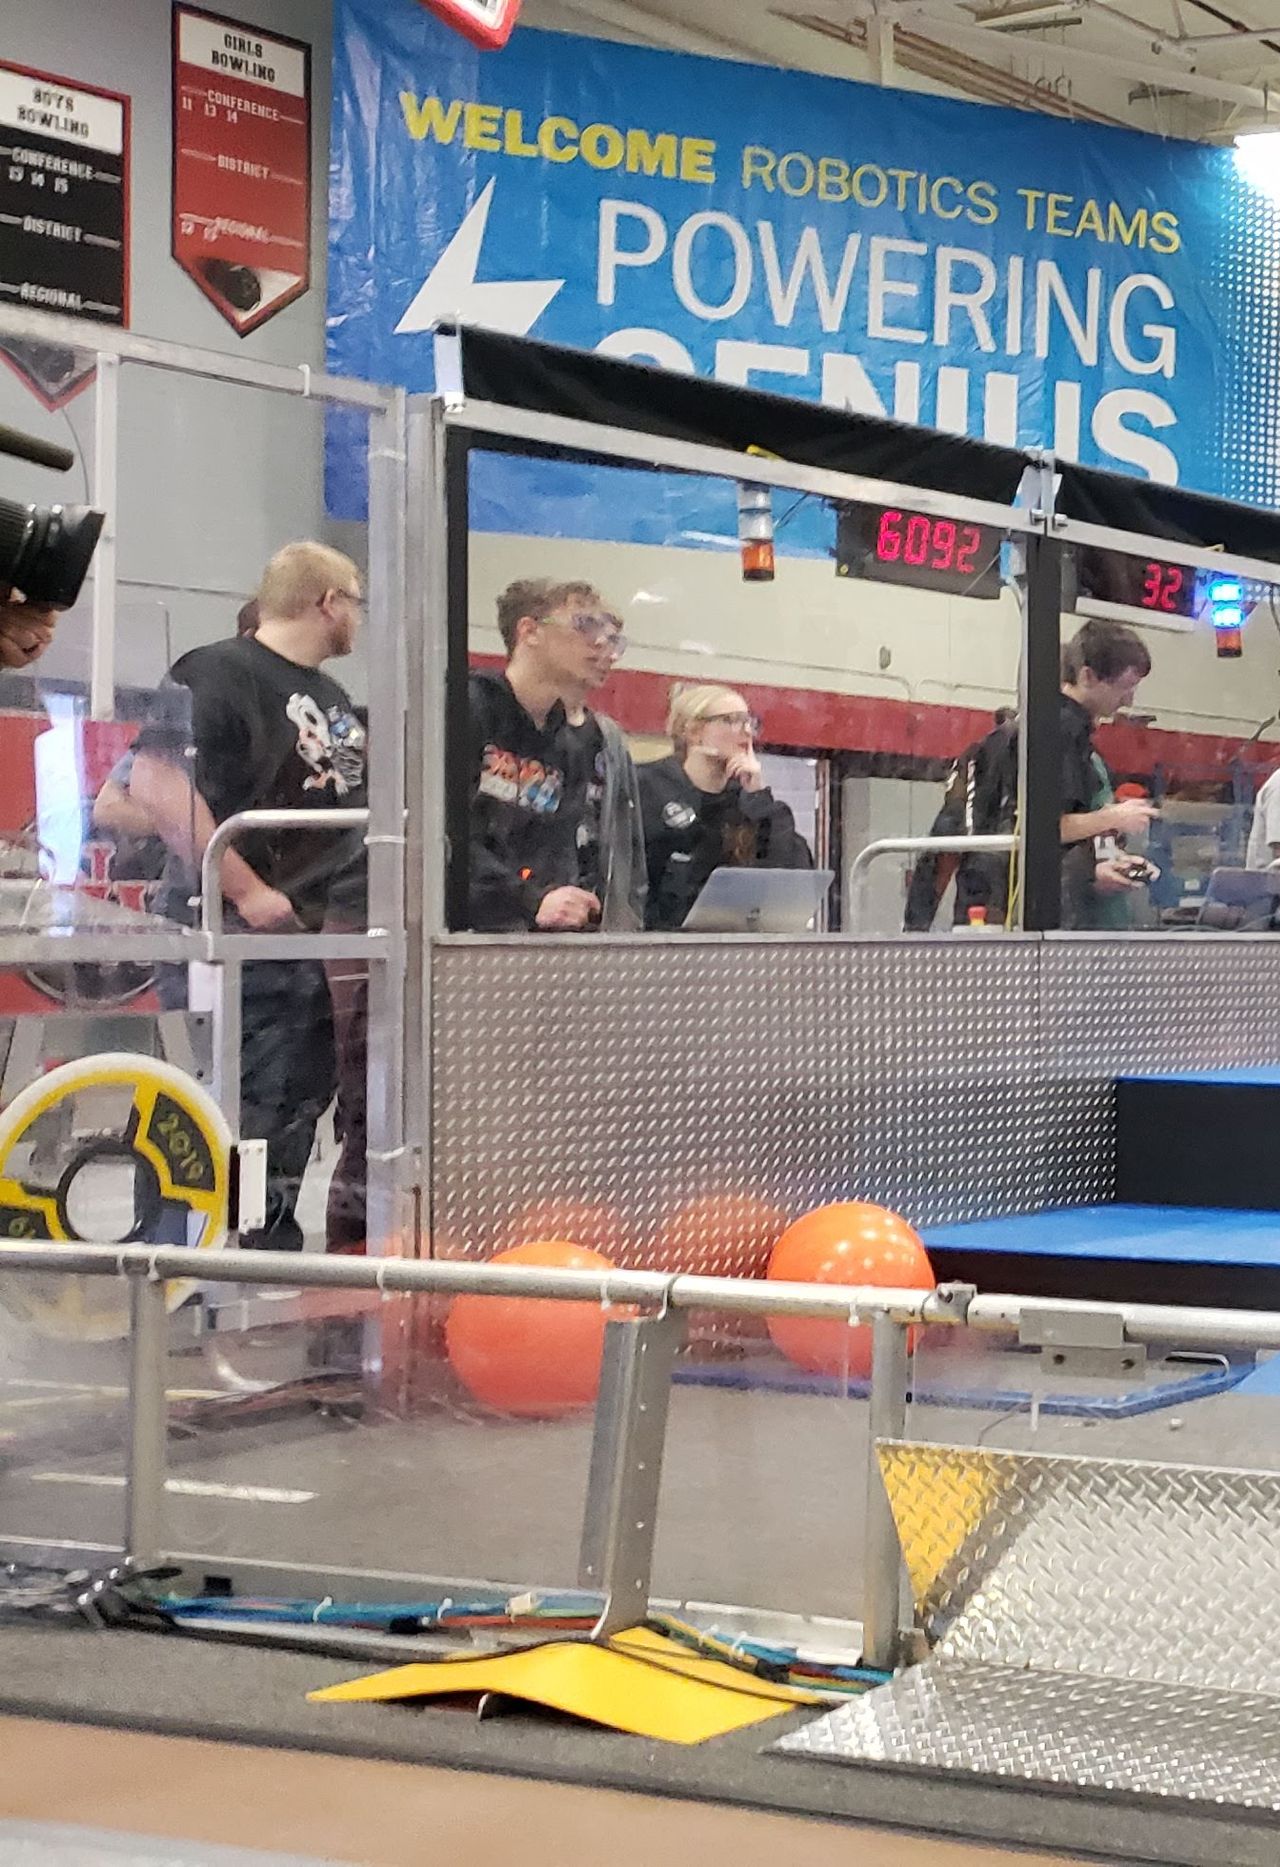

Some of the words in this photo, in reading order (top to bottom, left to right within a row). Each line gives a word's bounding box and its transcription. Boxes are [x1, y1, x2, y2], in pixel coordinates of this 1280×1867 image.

[224, 33, 263, 58] GIRLS
[211, 50, 275, 83] BOWLING
[32, 87, 74, 113] BOYS
[207, 89, 280, 121] CONFERENCE
[17, 104, 90, 139] BOWLING
[12, 146, 95, 181] CONFERENCE
[217, 154, 270, 180] DISTRICT
[399, 91, 717, 184] WELCOME
[741, 145, 1000, 225] ROBOTICS
[1017, 188, 1182, 254] TEAMS
[23, 215, 83, 242] DISTRICT
[20, 282, 82, 311] REGIONAL
[597, 197, 1178, 379] POWERING
[876, 509, 982, 574] 6092
[1141, 562, 1184, 611] 32
